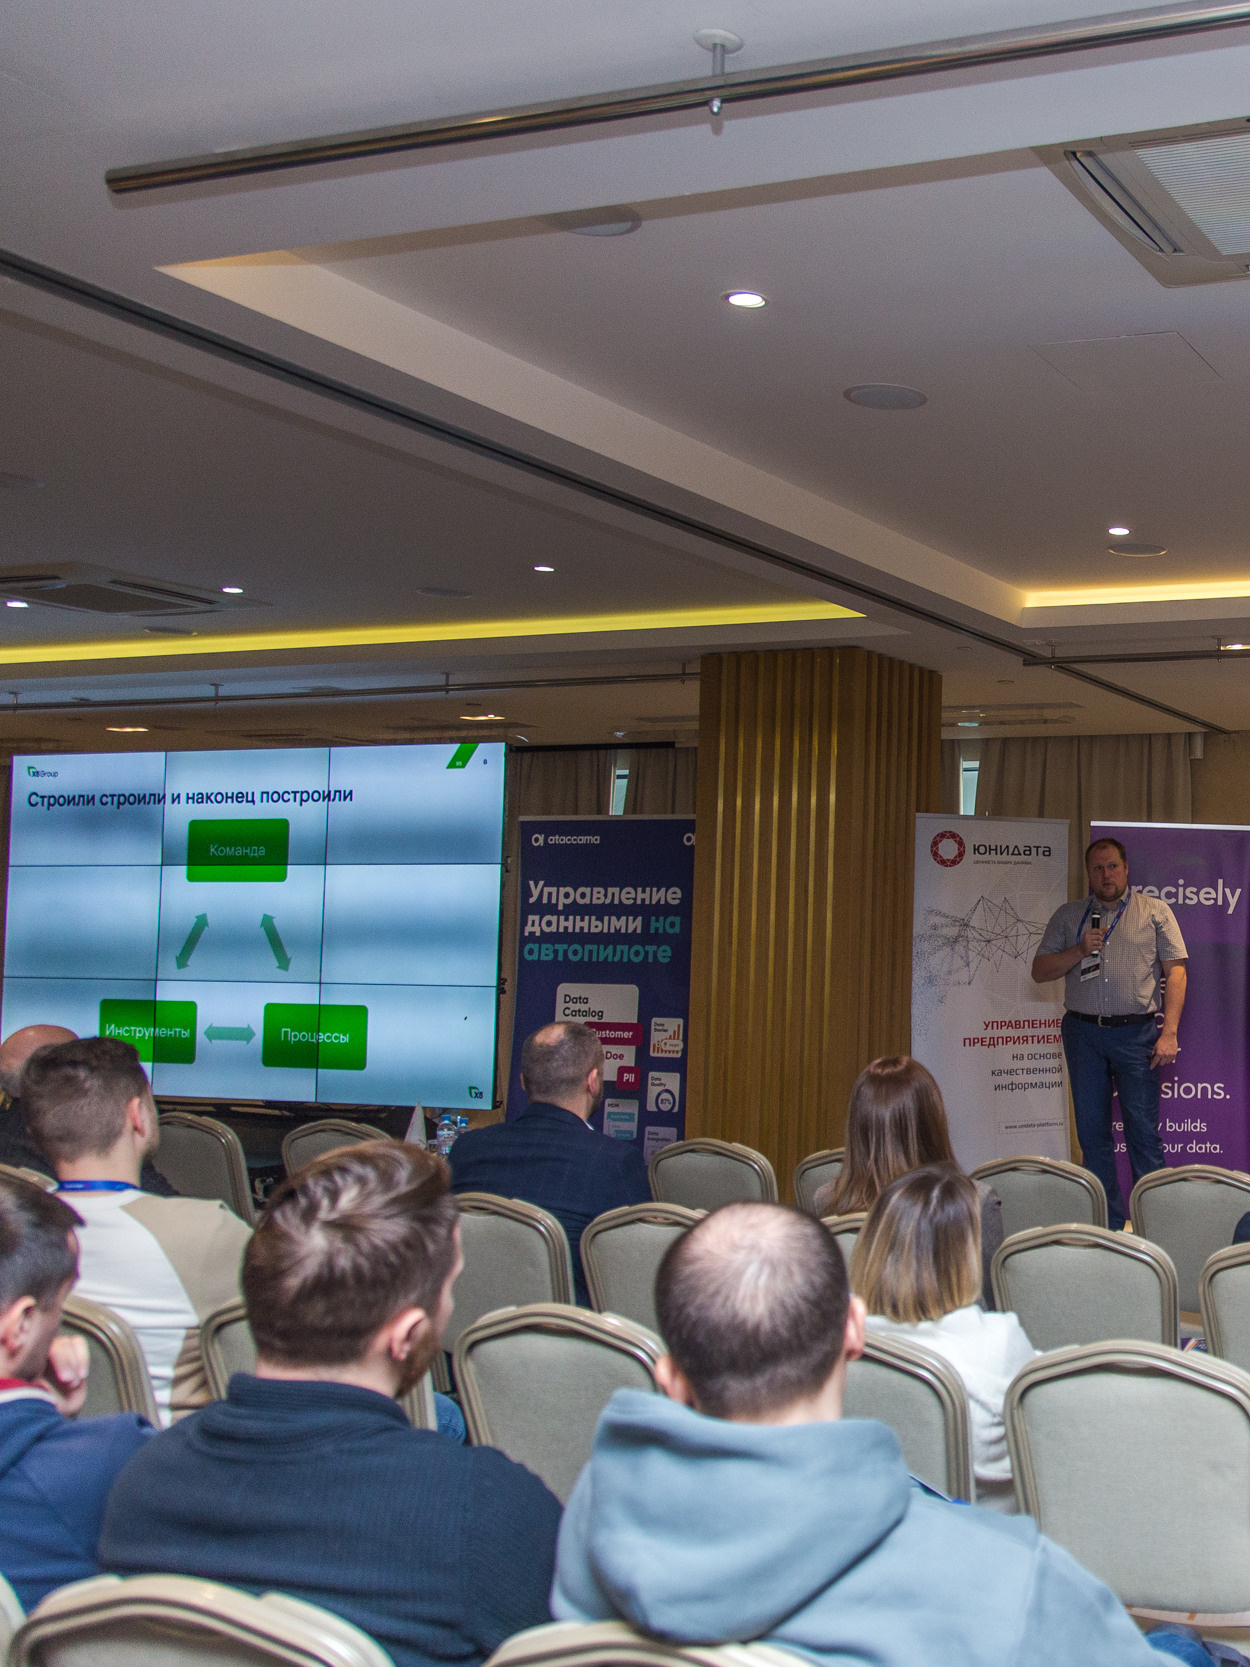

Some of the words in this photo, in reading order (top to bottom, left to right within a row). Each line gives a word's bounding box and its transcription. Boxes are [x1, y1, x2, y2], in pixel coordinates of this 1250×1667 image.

[28, 792, 96, 810] Строили
[100, 792, 166, 810] строили
[171, 792, 181, 804] и
[186, 791, 256, 806] наконец
[260, 789, 354, 806] построили
[548, 834, 600, 844] ataccama
[210, 844, 266, 858] Команда
[528, 880, 682, 910] Управление
[1131, 879, 1242, 914] recisely
[524, 914, 642, 936] данными
[650, 916, 681, 934] на
[523, 943, 672, 963] автопилоте
[564, 994, 589, 1004] Data
[562, 1007, 604, 1020] Catalog
[105, 1024, 190, 1039] Инструменты
[983, 1019, 1061, 1031] УПРАВЛЕНИЕ
[280, 1028, 349, 1044] Процессы
[592, 1028, 633, 1038] ustomer
[963, 1034, 1062, 1048] ПРЕДПРИЯТИЕМ
[605, 1051, 624, 1060] Doe
[1027, 1052, 1062, 1060] основе
[991, 1065, 1062, 1076] качественной
[994, 1080, 1063, 1092] информации
[1166, 1118, 1207, 1132] builds
[1163, 1142, 1183, 1153] our
[1187, 1140, 1223, 1153] data.
